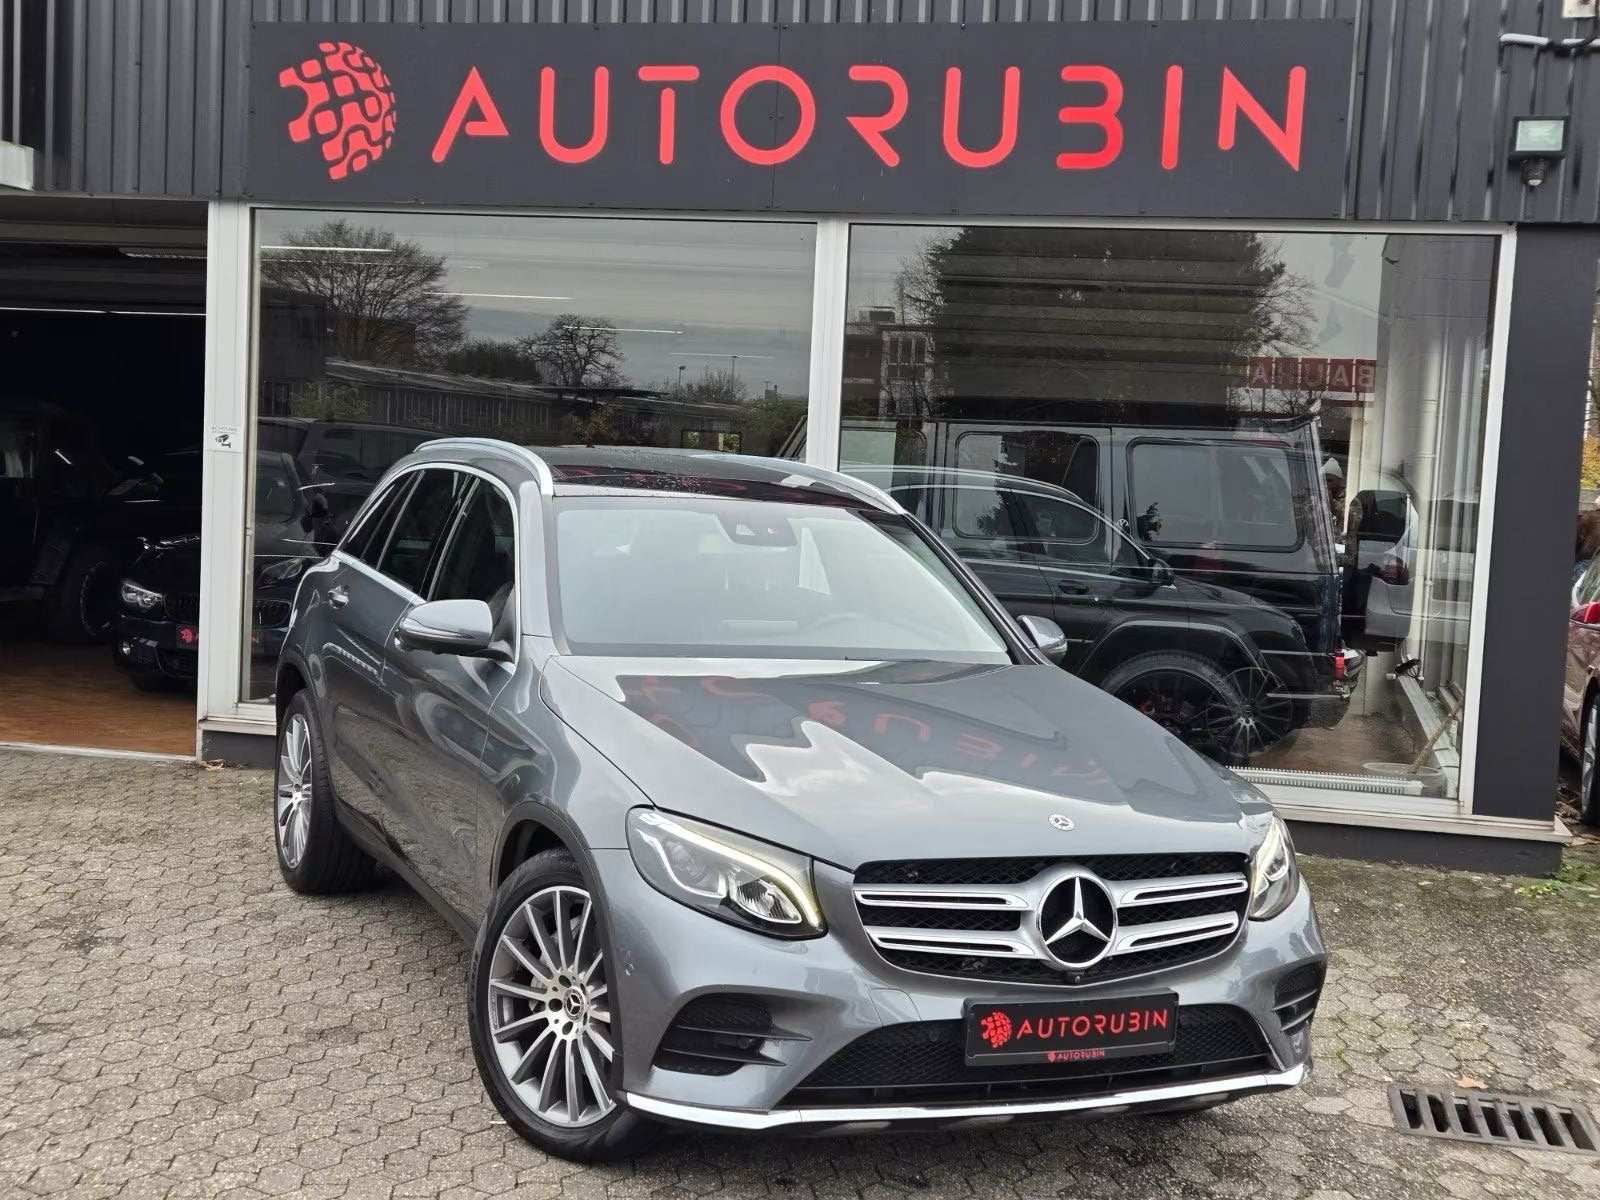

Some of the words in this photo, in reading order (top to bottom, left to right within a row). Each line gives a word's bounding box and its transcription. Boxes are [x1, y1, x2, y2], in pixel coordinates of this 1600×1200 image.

[431, 64, 1307, 171] AUTORUBIN
[1016, 1009, 1168, 1039] AUTORUBIN
[1057, 1050, 1105, 1060] AUTORUBIN
